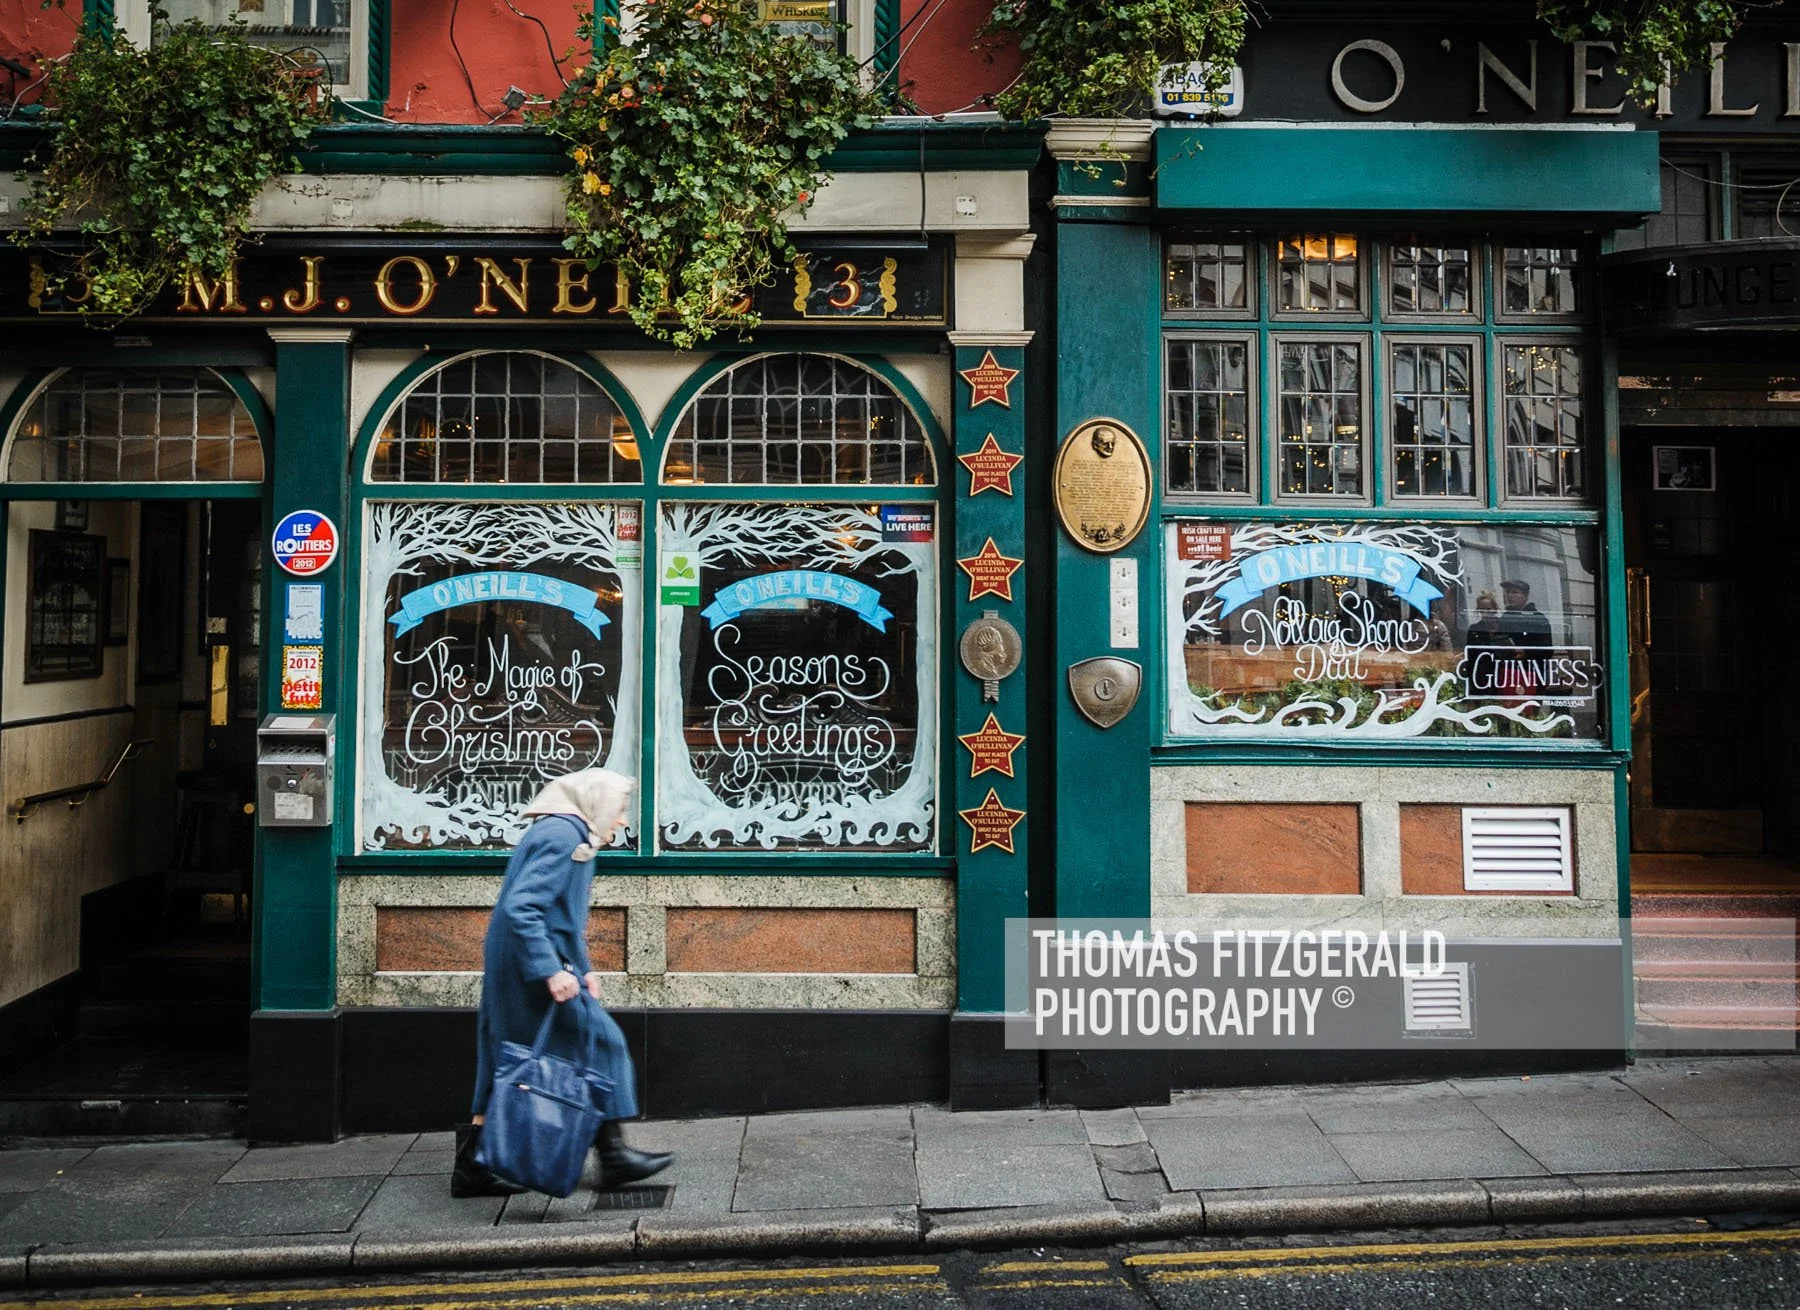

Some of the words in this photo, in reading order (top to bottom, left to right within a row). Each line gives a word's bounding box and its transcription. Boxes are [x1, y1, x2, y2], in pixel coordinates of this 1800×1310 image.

[1167, 93, 1179, 102] 01
[1182, 93, 1202, 102] 839
[1204, 93, 1229, 102] 5116
[374, 256, 752, 315] O'NEI
[830, 262, 862, 309] 3
[621, 511, 637, 519] 2012
[886, 522, 907, 532] LIVE
[908, 522, 933, 532] HERE
[292, 523, 312, 537] LES
[1181, 527, 1196, 535] IRISH
[1196, 527, 1213, 535] CRAFT
[1213, 527, 1226, 535] BEER
[1186, 535, 1195, 543] ON
[1195, 535, 1208, 543] SALE
[1208, 535, 1222, 543] HERE
[276, 538, 333, 554] ROUTIERS
[295, 560, 314, 568] 2012
[1256, 544, 1406, 586] O'NEILL'S
[433, 574, 564, 606] O'NEILL'S
[734, 573, 863, 606] O'NEILL'S
[1241, 595, 1346, 662] Nollaig
[1339, 590, 1430, 657] Shona
[289, 657, 317, 669] 2012
[394, 635, 471, 702] The
[474, 634, 556, 710] Magic
[561, 649, 606, 705] of
[708, 624, 890, 705] Seasons
[1472, 651, 1589, 690] GUINNESS
[283, 681, 321, 695] petit
[405, 700, 603, 780] Christmas
[713, 691, 896, 793] Greetings
[971, 742, 1013, 750] O'SULLIVAN
